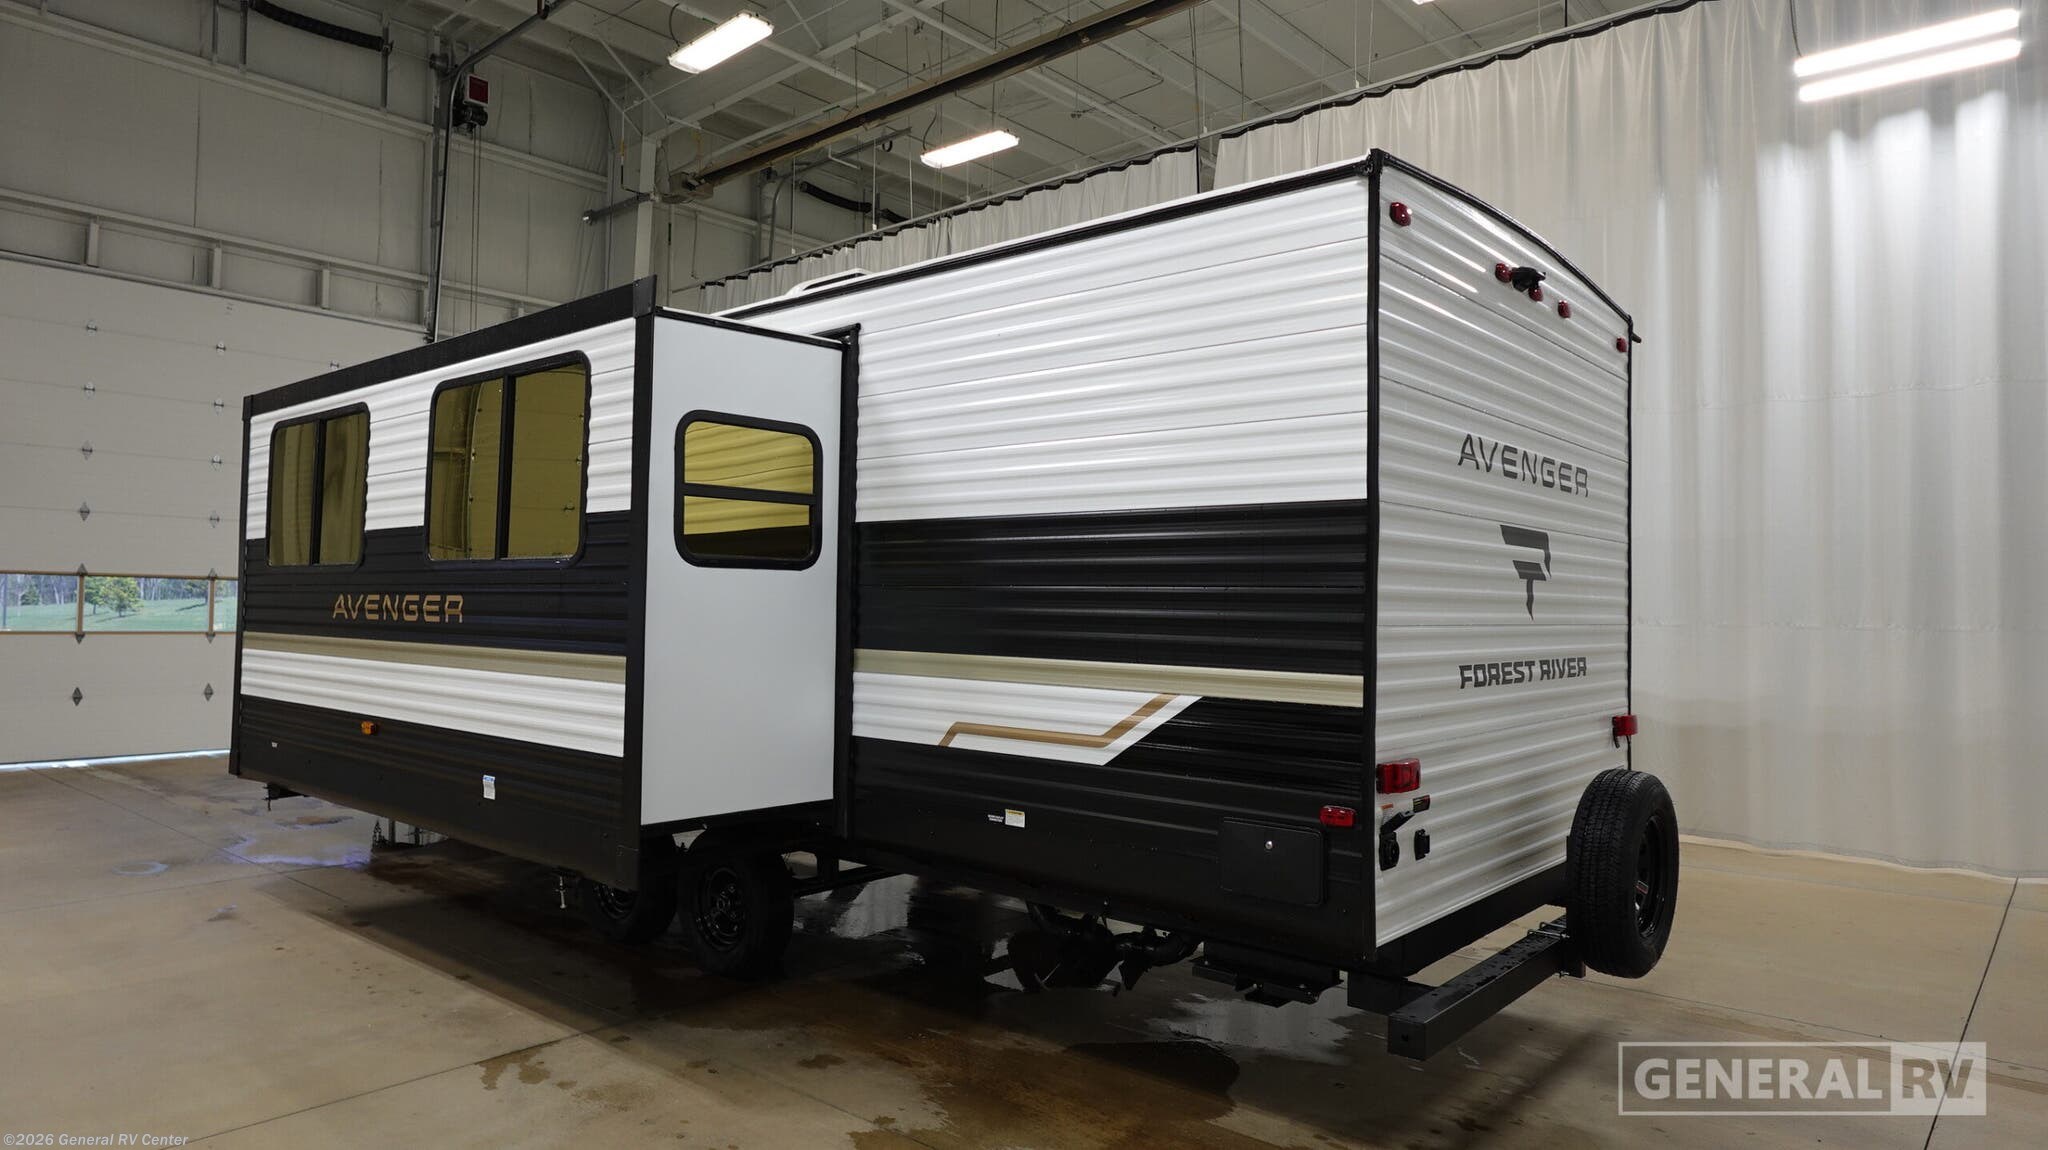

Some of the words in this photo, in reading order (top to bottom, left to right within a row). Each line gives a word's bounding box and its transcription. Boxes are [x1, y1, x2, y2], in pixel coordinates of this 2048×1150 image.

[1457, 433, 1589, 497] AVENGER
[332, 594, 464, 623] AVENGER
[1459, 660, 1536, 689] FOREST
[1539, 656, 1587, 681] RIVER
